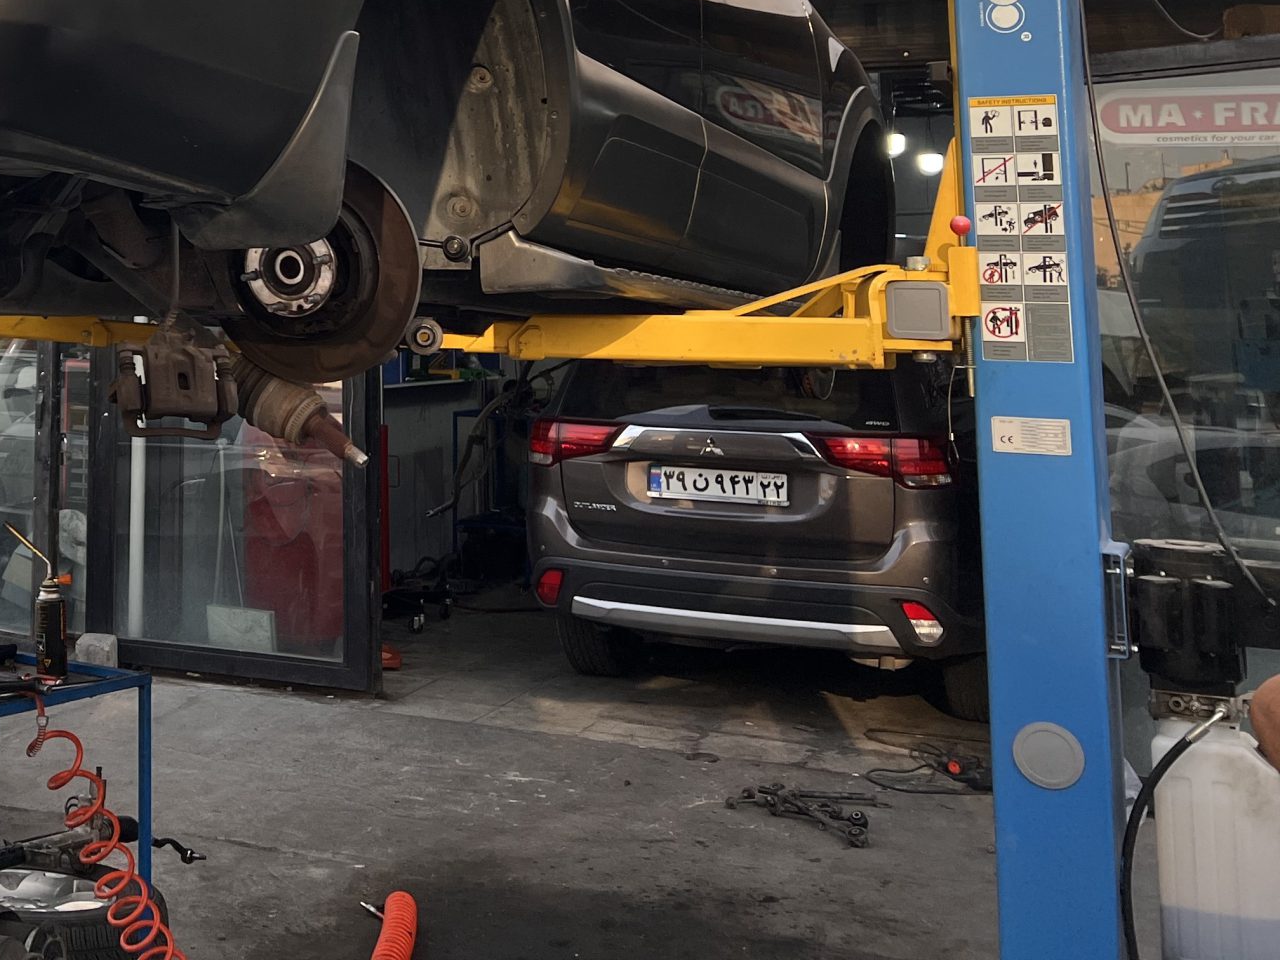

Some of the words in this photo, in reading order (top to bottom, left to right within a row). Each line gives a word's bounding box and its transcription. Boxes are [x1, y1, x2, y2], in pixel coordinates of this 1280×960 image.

[1214, 101, 1280, 126] FR
[1156, 135, 1209, 143] cosmetics
[1211, 134, 1229, 142] for
[1231, 135, 1256, 144] your
